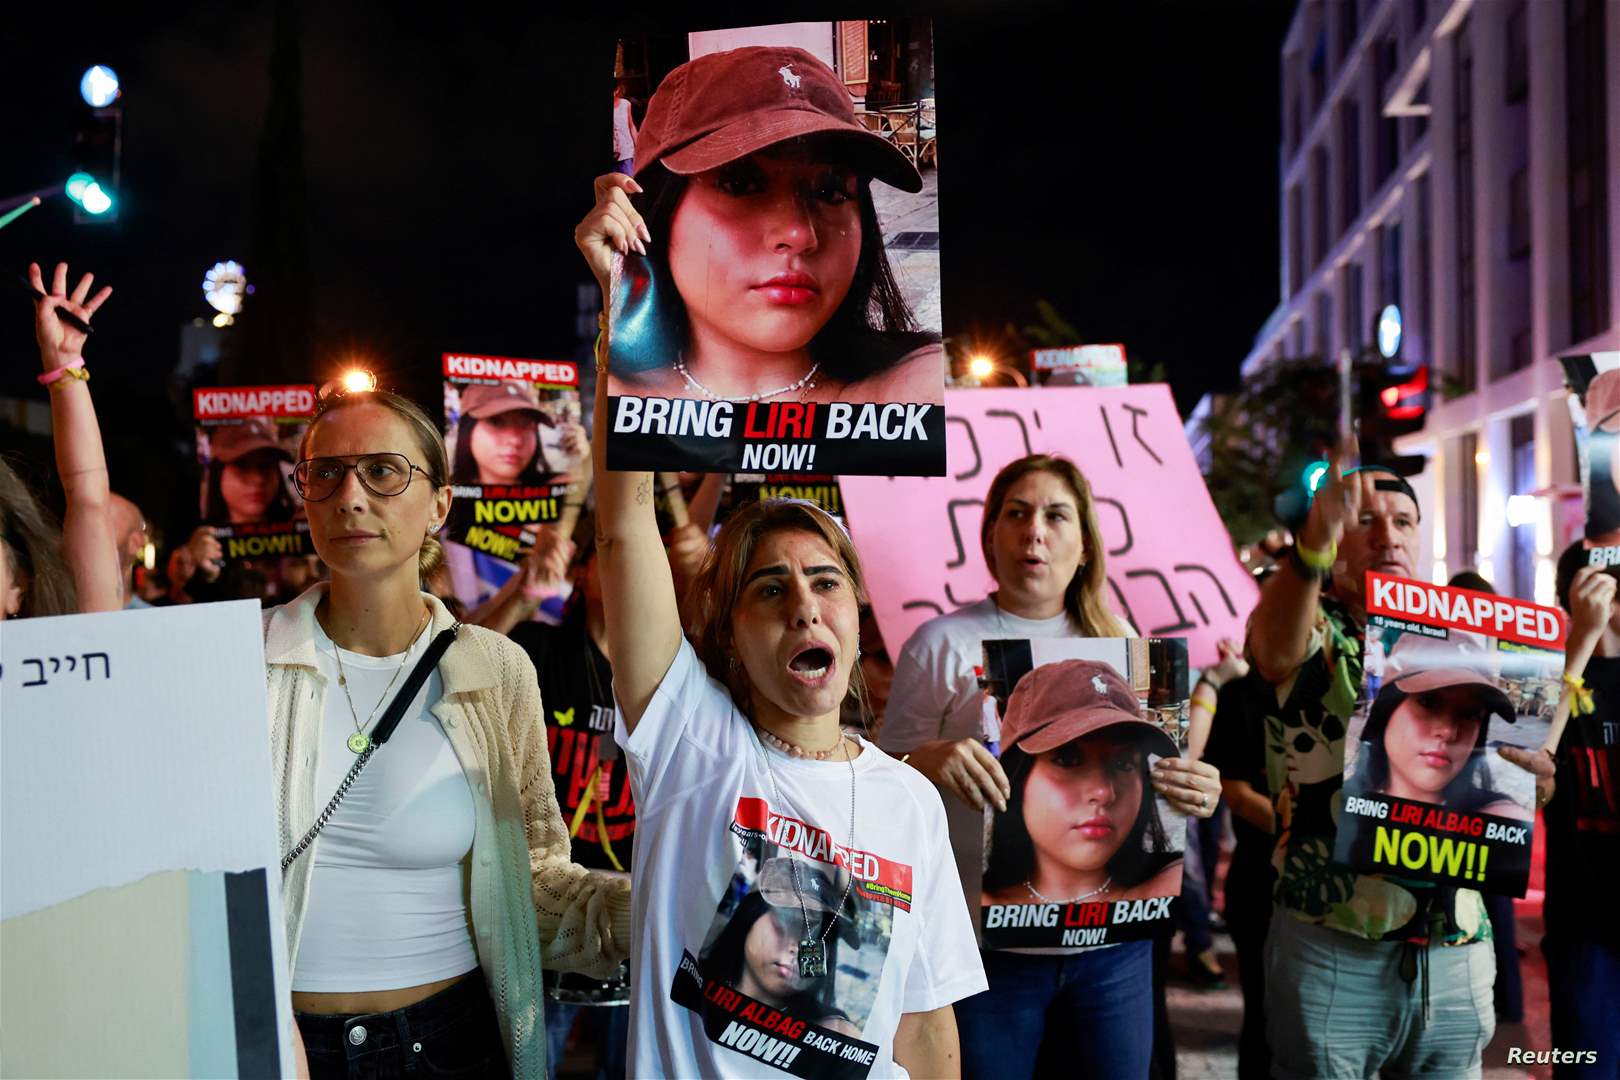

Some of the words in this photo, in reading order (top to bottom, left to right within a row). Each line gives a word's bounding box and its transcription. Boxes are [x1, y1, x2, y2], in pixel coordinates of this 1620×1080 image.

[447, 356, 575, 382] KIDNAPPED
[198, 390, 313, 415] KIDNAPPED
[614, 397, 733, 438] BRING
[743, 402, 816, 439] LIRI
[825, 403, 931, 440] BACK
[741, 444, 816, 470] NOW!
[475, 499, 558, 524] NOW!!
[228, 534, 302, 558] NOW!!
[1373, 578, 1560, 641] KIDNAPPED
[22, 652, 110, 687] חייב
[1345, 797, 1388, 819] BRING
[1391, 803, 1424, 826] LIRI
[1424, 811, 1484, 836] ALBAG
[1485, 822, 1527, 845] BACK
[1374, 826, 1489, 882] NOW!!
[986, 904, 1059, 928] BRING
[1064, 902, 1109, 927] LIRI
[1112, 896, 1175, 924] BACK
[1061, 928, 1107, 946] NOW!
[704, 980, 744, 1013] LIRI
[739, 1002, 808, 1041] ALBAG
[803, 1030, 842, 1055] BACK
[840, 1045, 876, 1066] HOME
[718, 1020, 802, 1068] NOW!!
